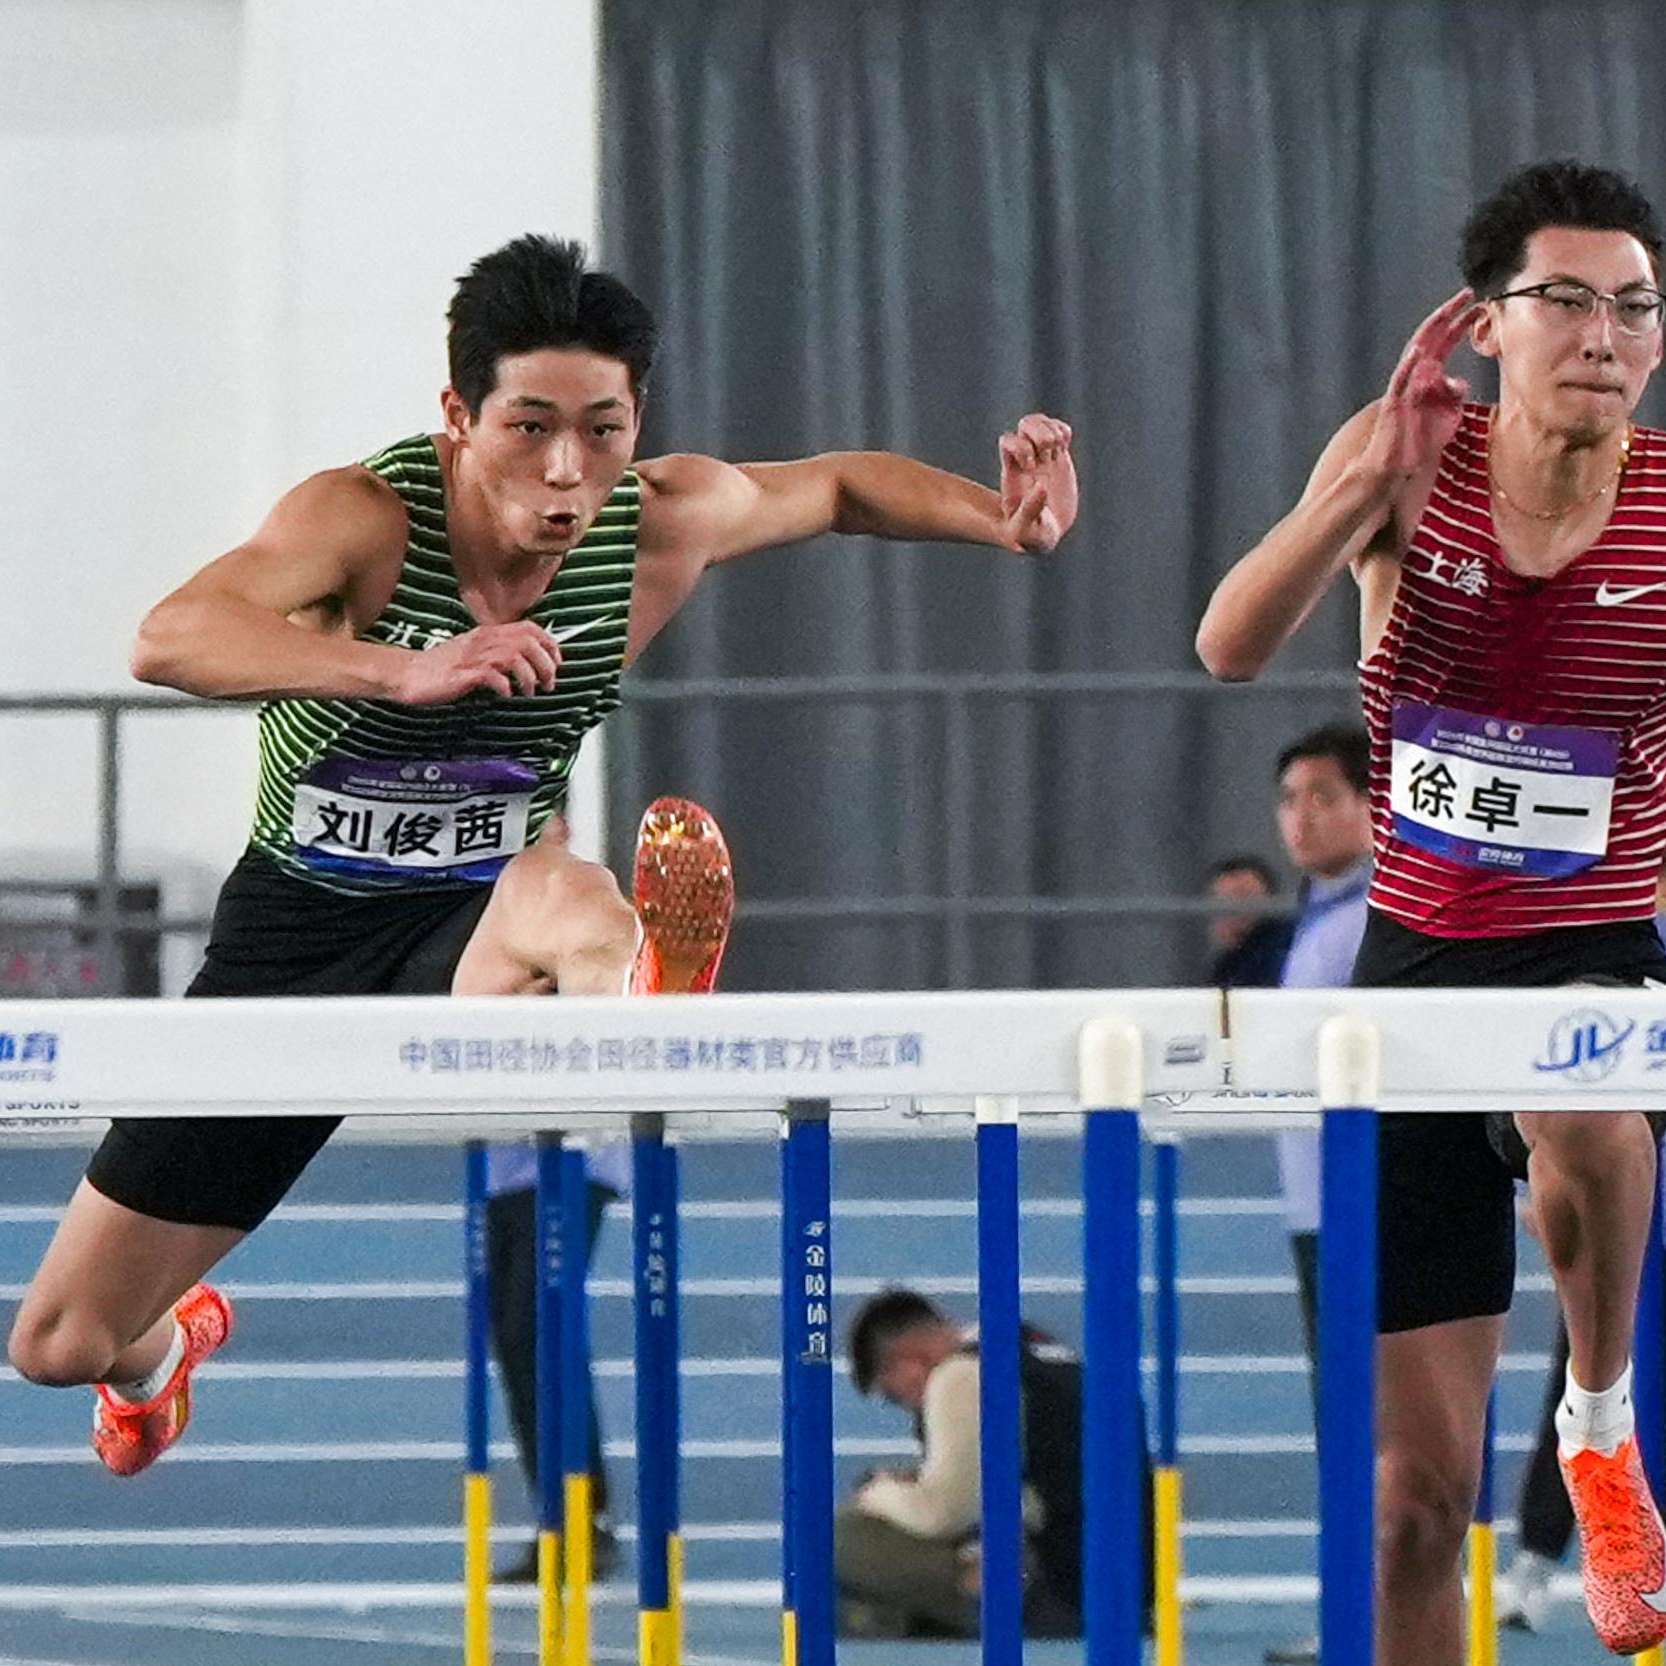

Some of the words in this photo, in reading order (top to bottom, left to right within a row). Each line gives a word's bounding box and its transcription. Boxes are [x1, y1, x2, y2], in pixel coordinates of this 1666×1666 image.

[1424, 551, 1490, 597] 上海
[1408, 759, 1590, 833] 徐卓一
[313, 799, 508, 857] 刘俊茜
